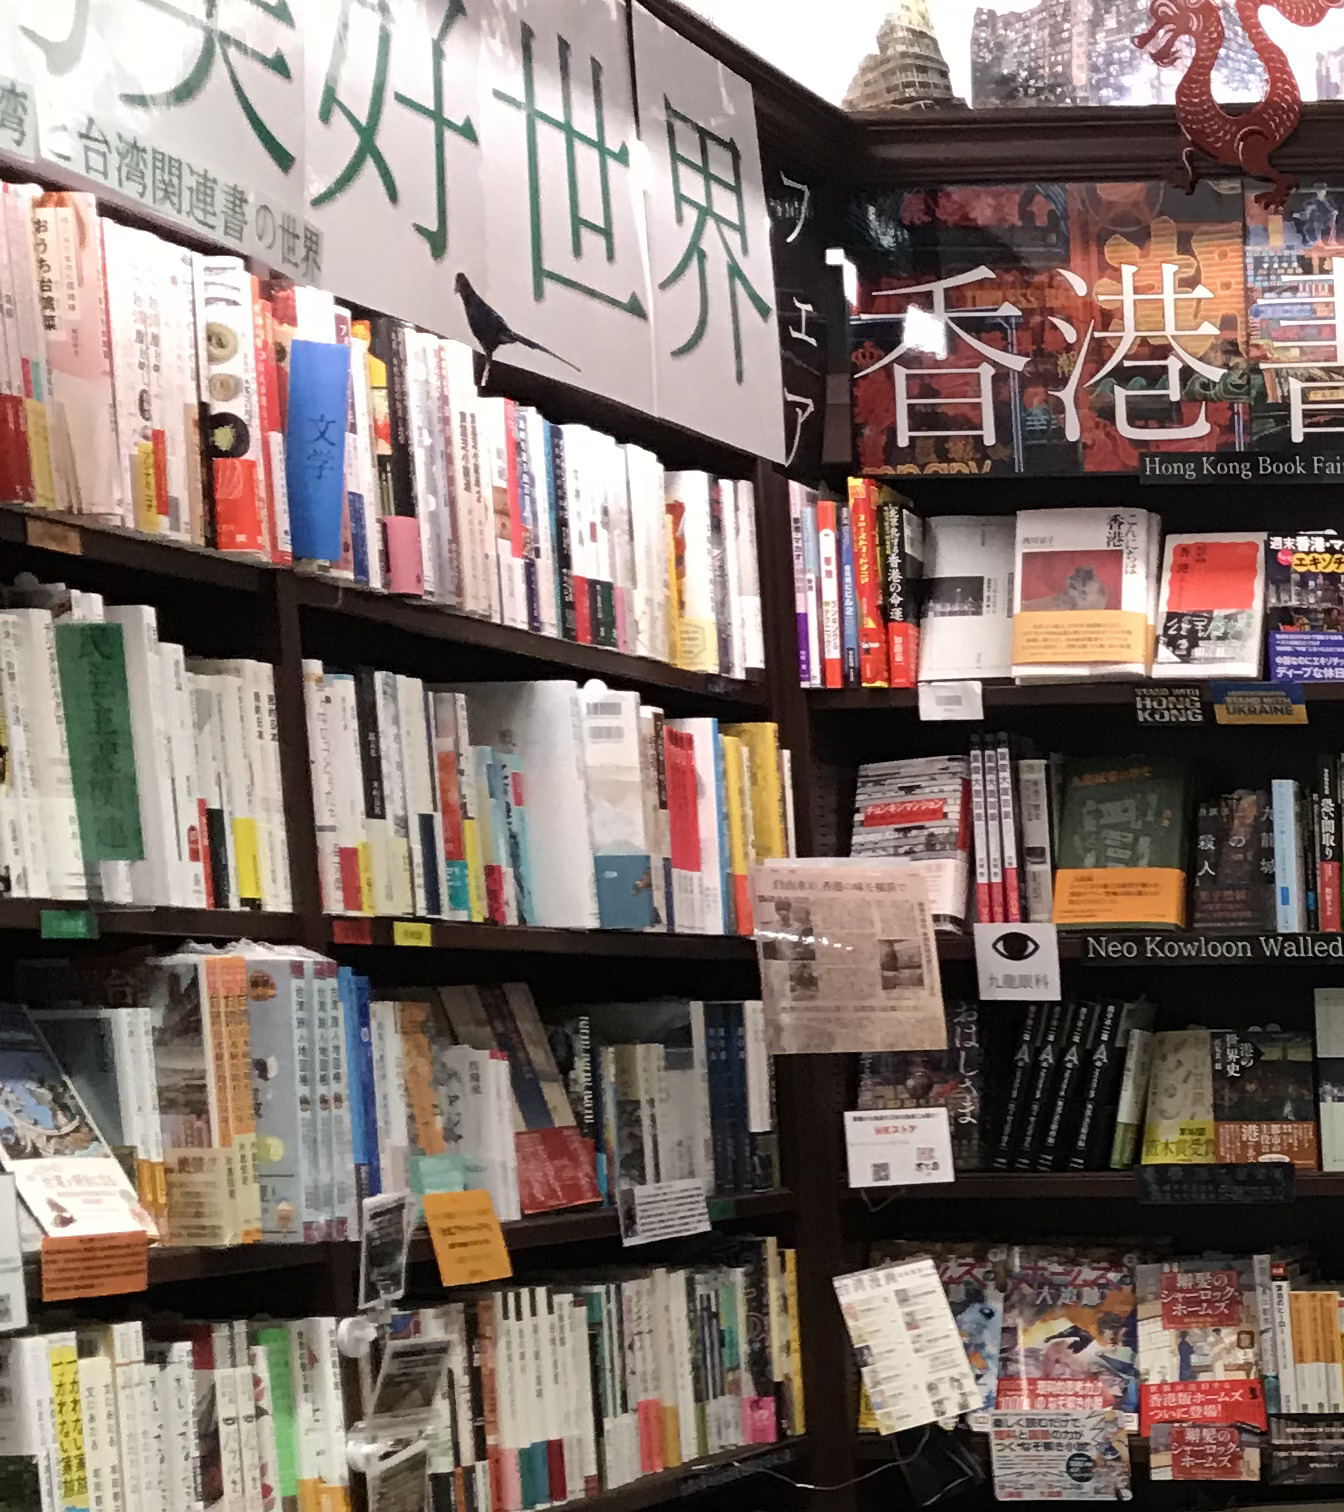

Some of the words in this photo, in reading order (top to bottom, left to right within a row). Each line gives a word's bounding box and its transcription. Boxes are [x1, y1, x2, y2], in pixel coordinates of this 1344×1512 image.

[306, 412, 336, 481] 文学
[1145, 457, 1196, 480] Hong
[1202, 457, 1252, 480] Kong
[1257, 457, 1306, 475] Book
[1105, 513, 1125, 548] 香港
[1124, 513, 1139, 576] こんにちは
[1136, 697, 1202, 711] HONG
[1225, 705, 1294, 717] UKRAINE
[1137, 709, 1203, 723] KONG
[1088, 936, 1137, 959] Neo
[1144, 936, 1252, 958] Kowloon
[1259, 936, 1344, 959] Walled
[1171, 1299, 1229, 1316] ホームズ
[1181, 1454, 1232, 1469] ホームズ
